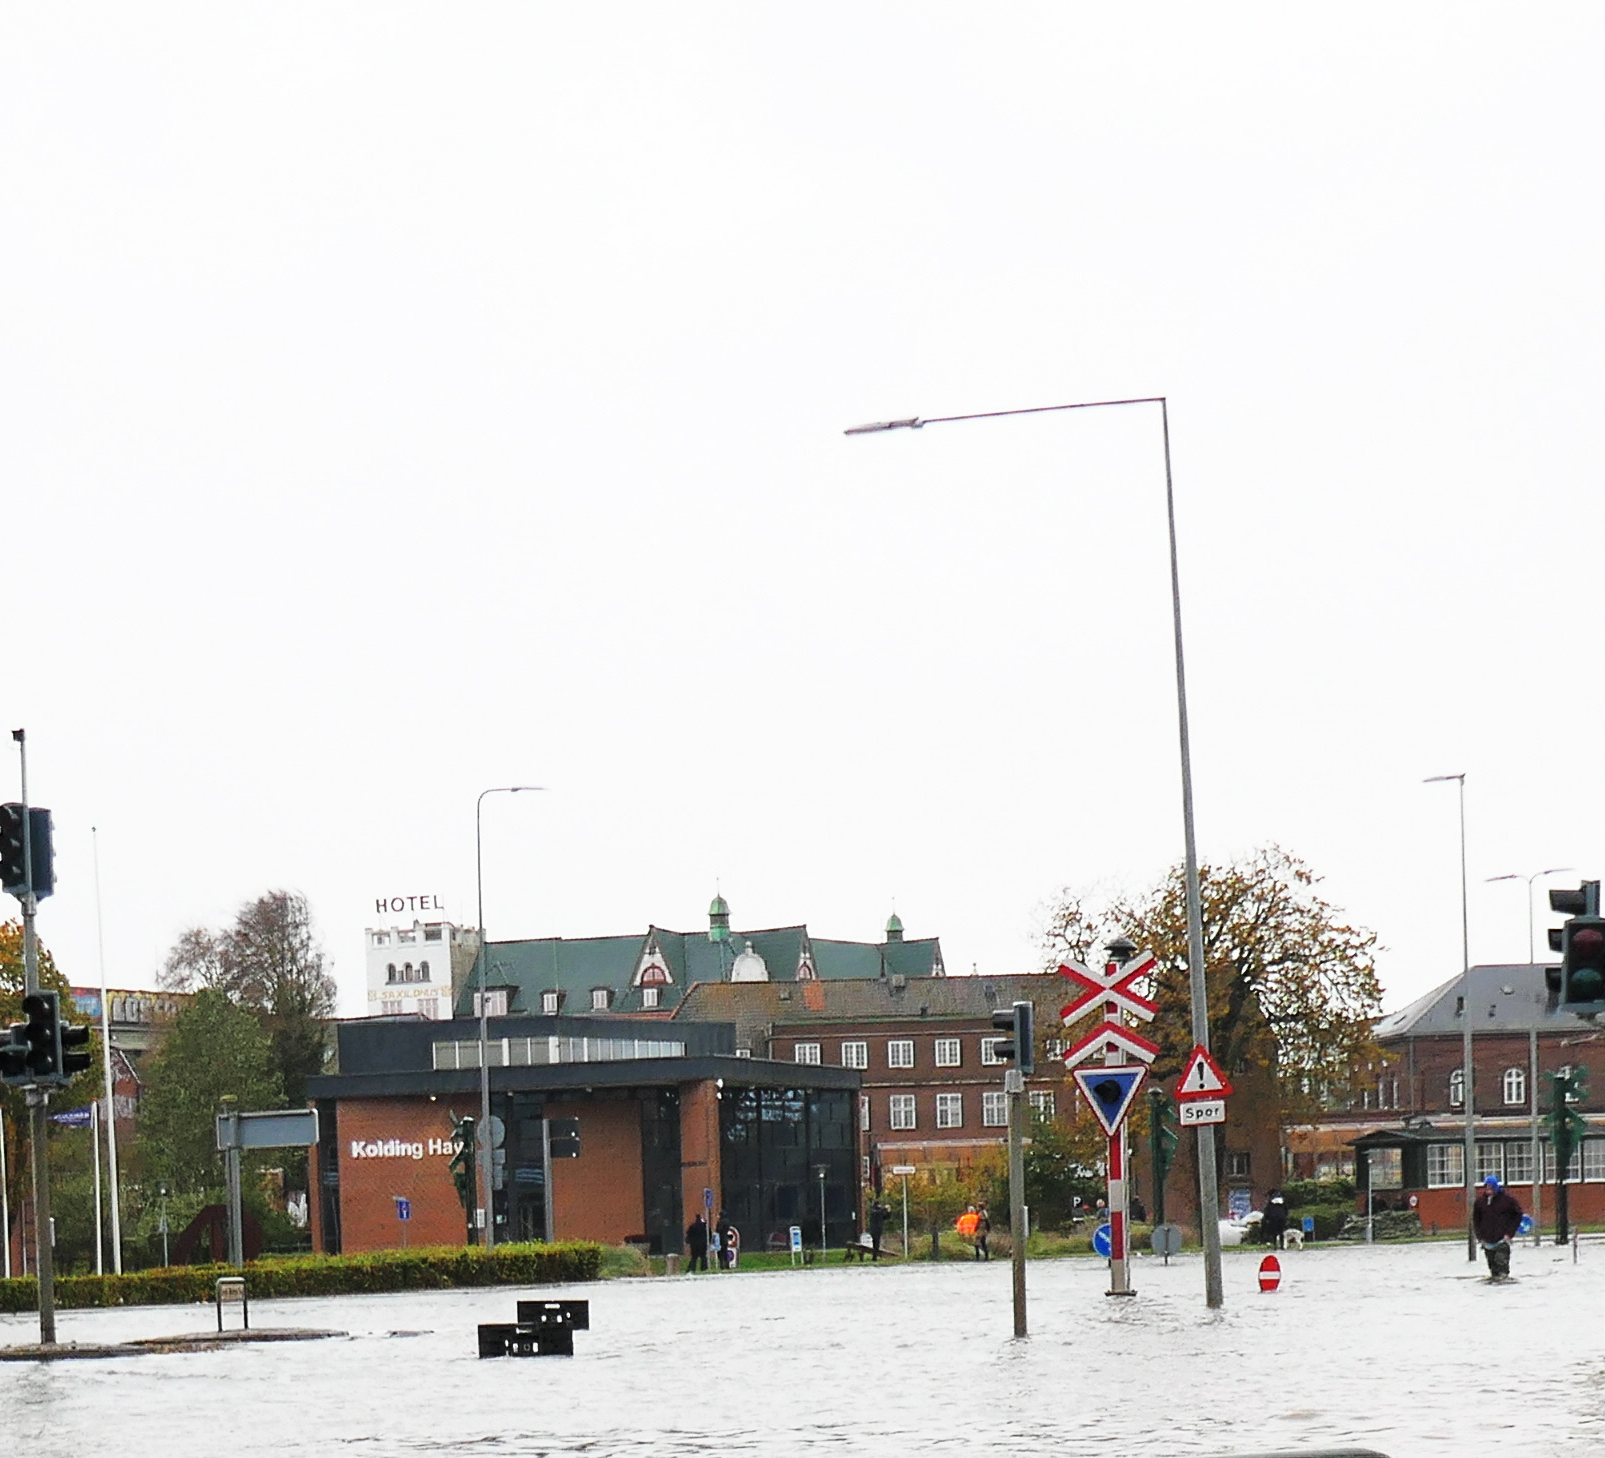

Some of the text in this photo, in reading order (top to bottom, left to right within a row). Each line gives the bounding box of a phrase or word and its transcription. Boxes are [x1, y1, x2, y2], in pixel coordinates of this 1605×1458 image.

[375, 894, 445, 914] HOTEL
[1185, 1107, 1219, 1119] Spor
[351, 1138, 473, 1160] Kolding Hav
